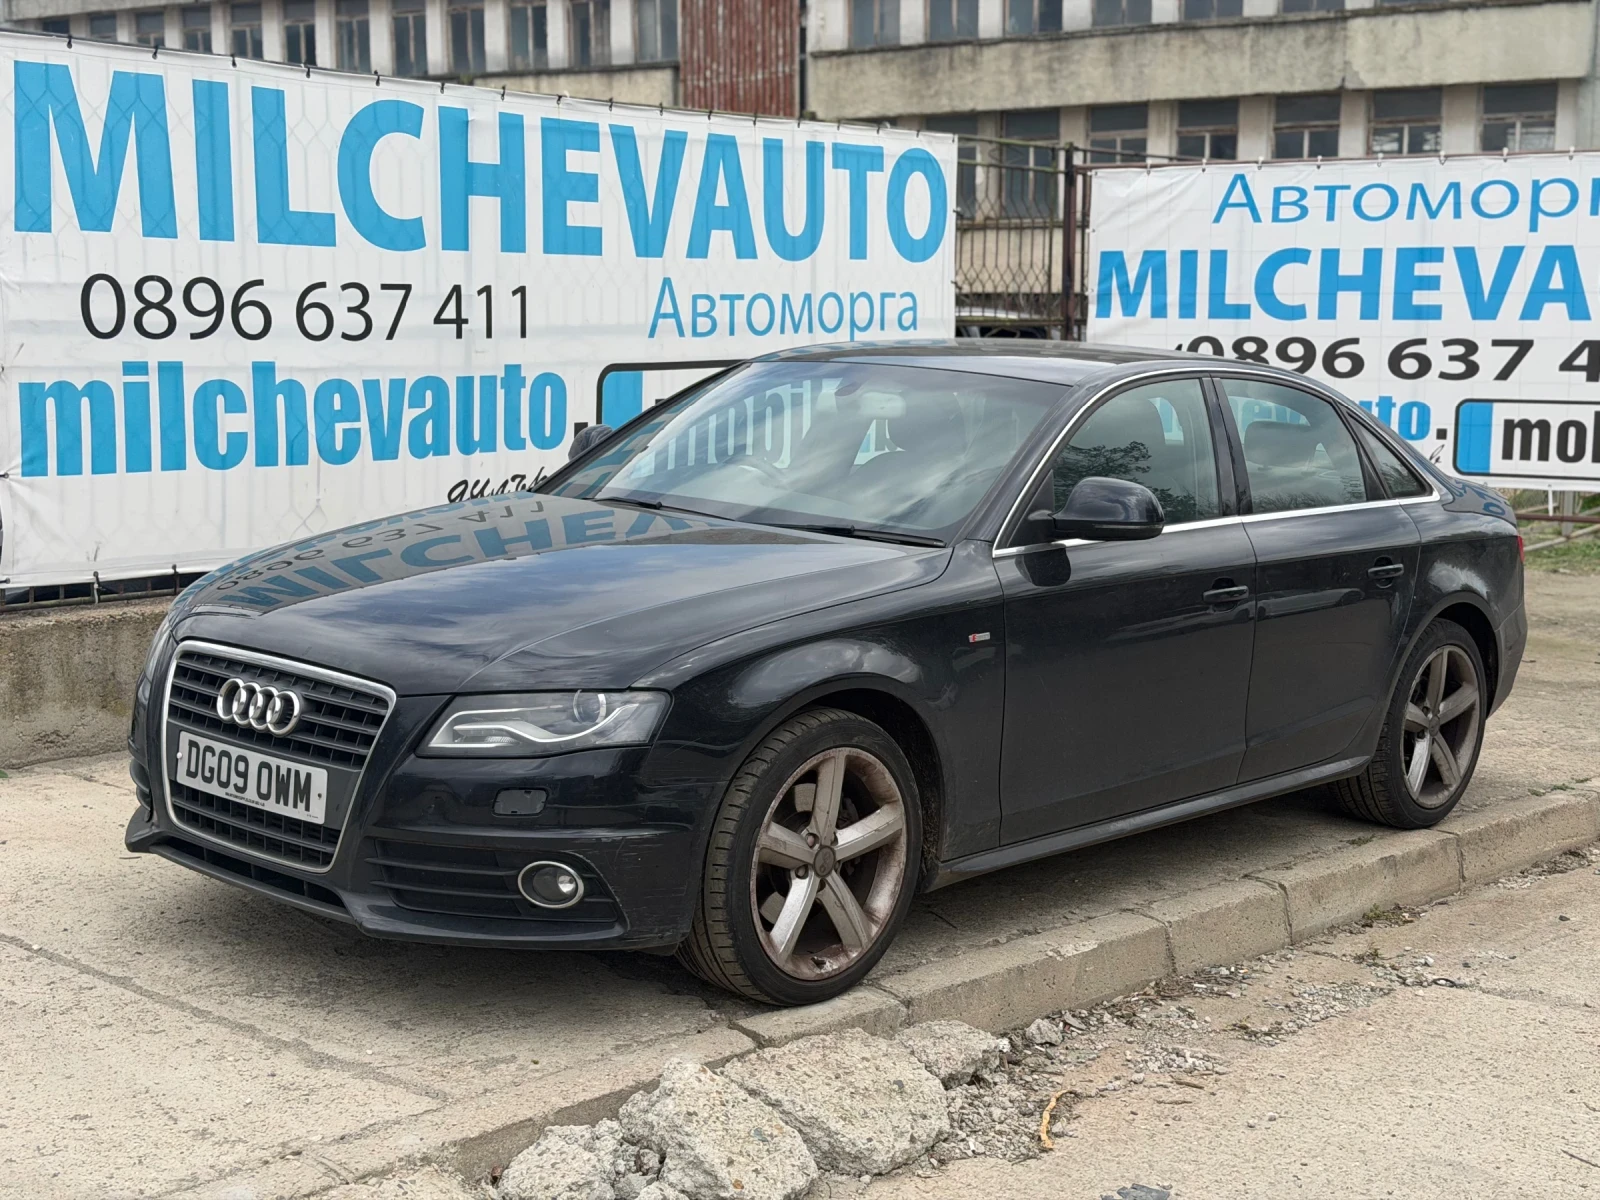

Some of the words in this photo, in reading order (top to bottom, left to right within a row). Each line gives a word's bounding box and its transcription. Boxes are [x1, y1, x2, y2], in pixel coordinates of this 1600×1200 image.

[14, 61, 948, 263] MILCHEVAUTO
[80, 274, 273, 341] 0896
[295, 282, 413, 342] 637
[433, 285, 528, 340] 411
[648, 277, 918, 341] Автоморга
[1096, 245, 1591, 321] MILCHEVA
[1387, 338, 1534, 381] 637
[186, 739, 249, 794] DG09
[256, 760, 312, 812] OWM
